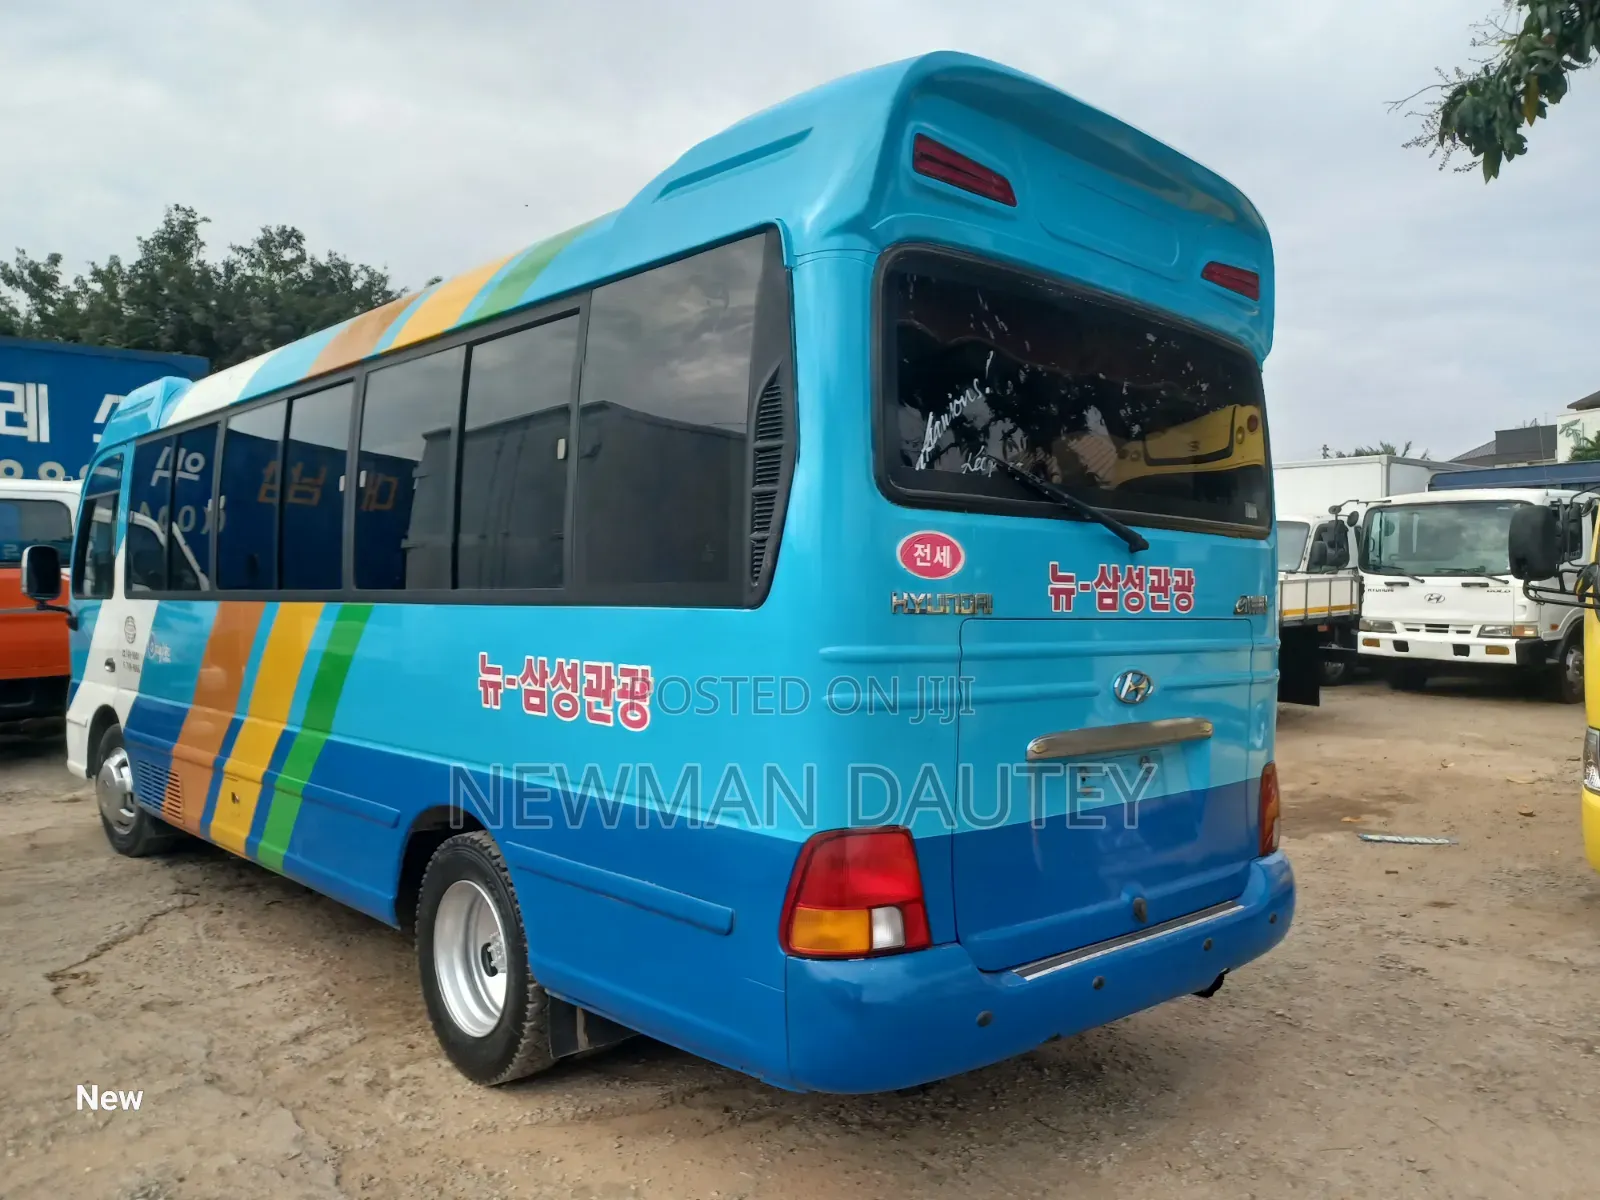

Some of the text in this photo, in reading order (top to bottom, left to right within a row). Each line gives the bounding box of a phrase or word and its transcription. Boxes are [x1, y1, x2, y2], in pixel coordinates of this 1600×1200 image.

[913, 543, 952, 569] 전세
[891, 591, 993, 615] HYUNDAI
[1048, 561, 1195, 614] 뉴-삼성관광
[478, 651, 653, 732] 뉴-삼성관광
